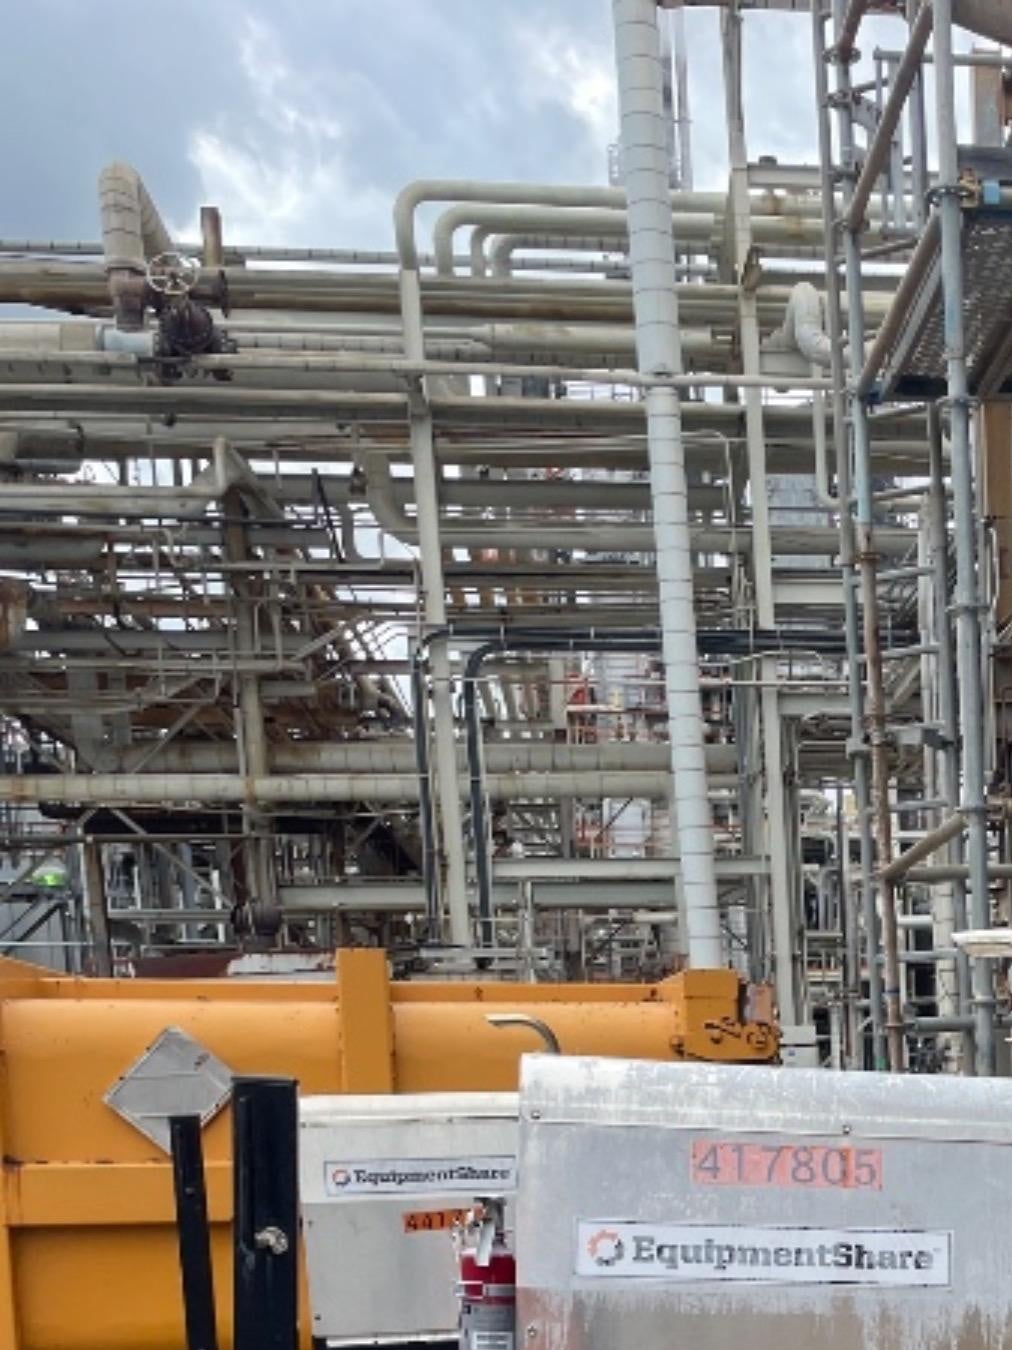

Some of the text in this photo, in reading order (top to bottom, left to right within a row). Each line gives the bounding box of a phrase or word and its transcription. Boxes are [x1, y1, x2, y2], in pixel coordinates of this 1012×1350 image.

[353, 1165, 511, 1186] EquipmentShare
[697, 1144, 877, 1186] 417805
[631, 1234, 935, 1271] EquipmentShare
